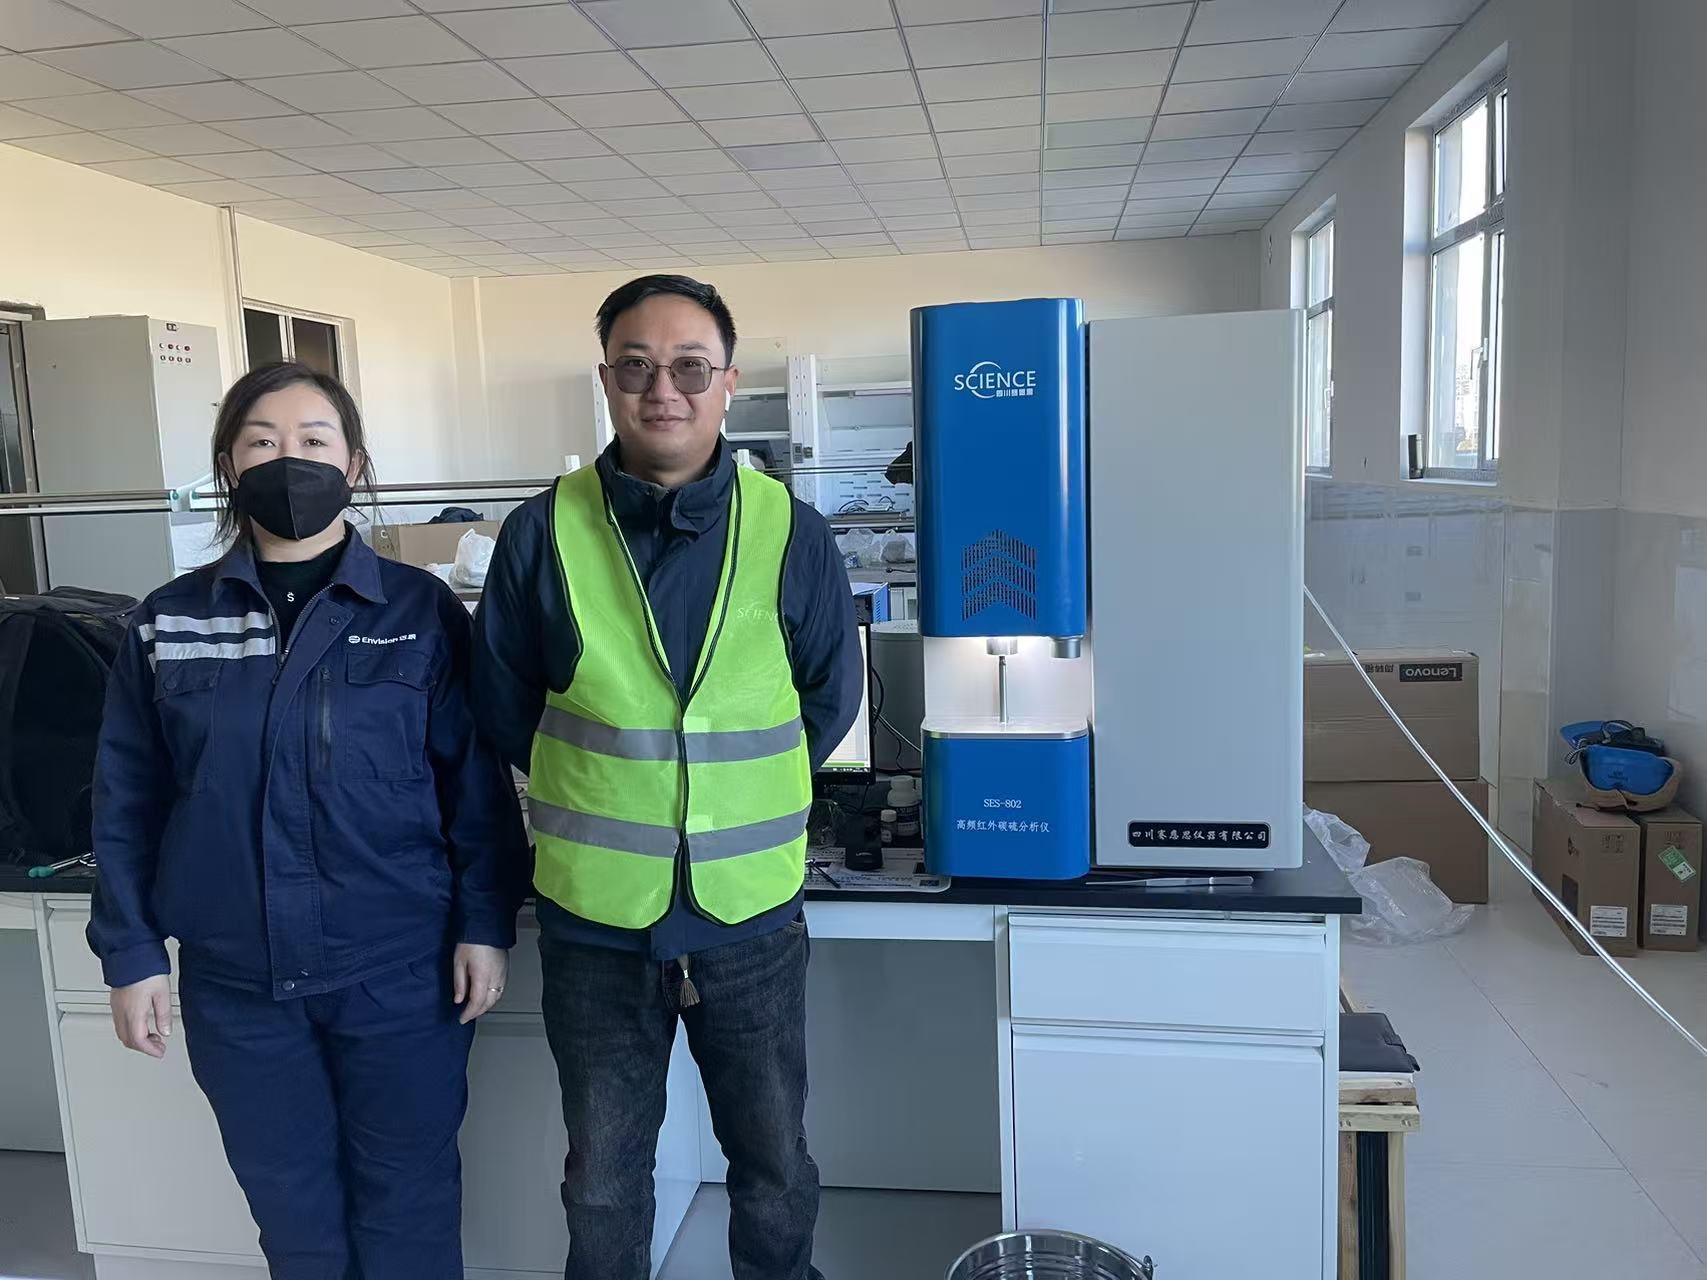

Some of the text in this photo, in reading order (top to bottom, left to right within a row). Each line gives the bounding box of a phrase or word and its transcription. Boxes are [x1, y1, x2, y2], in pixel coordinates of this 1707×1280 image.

[954, 370, 1037, 391] SCIENCE
[361, 636, 399, 645] Envision
[1405, 667, 1457, 678] Lenovo
[983, 798, 1022, 809] SES-802
[956, 819, 1050, 833] 高频红外碳硫分析仪
